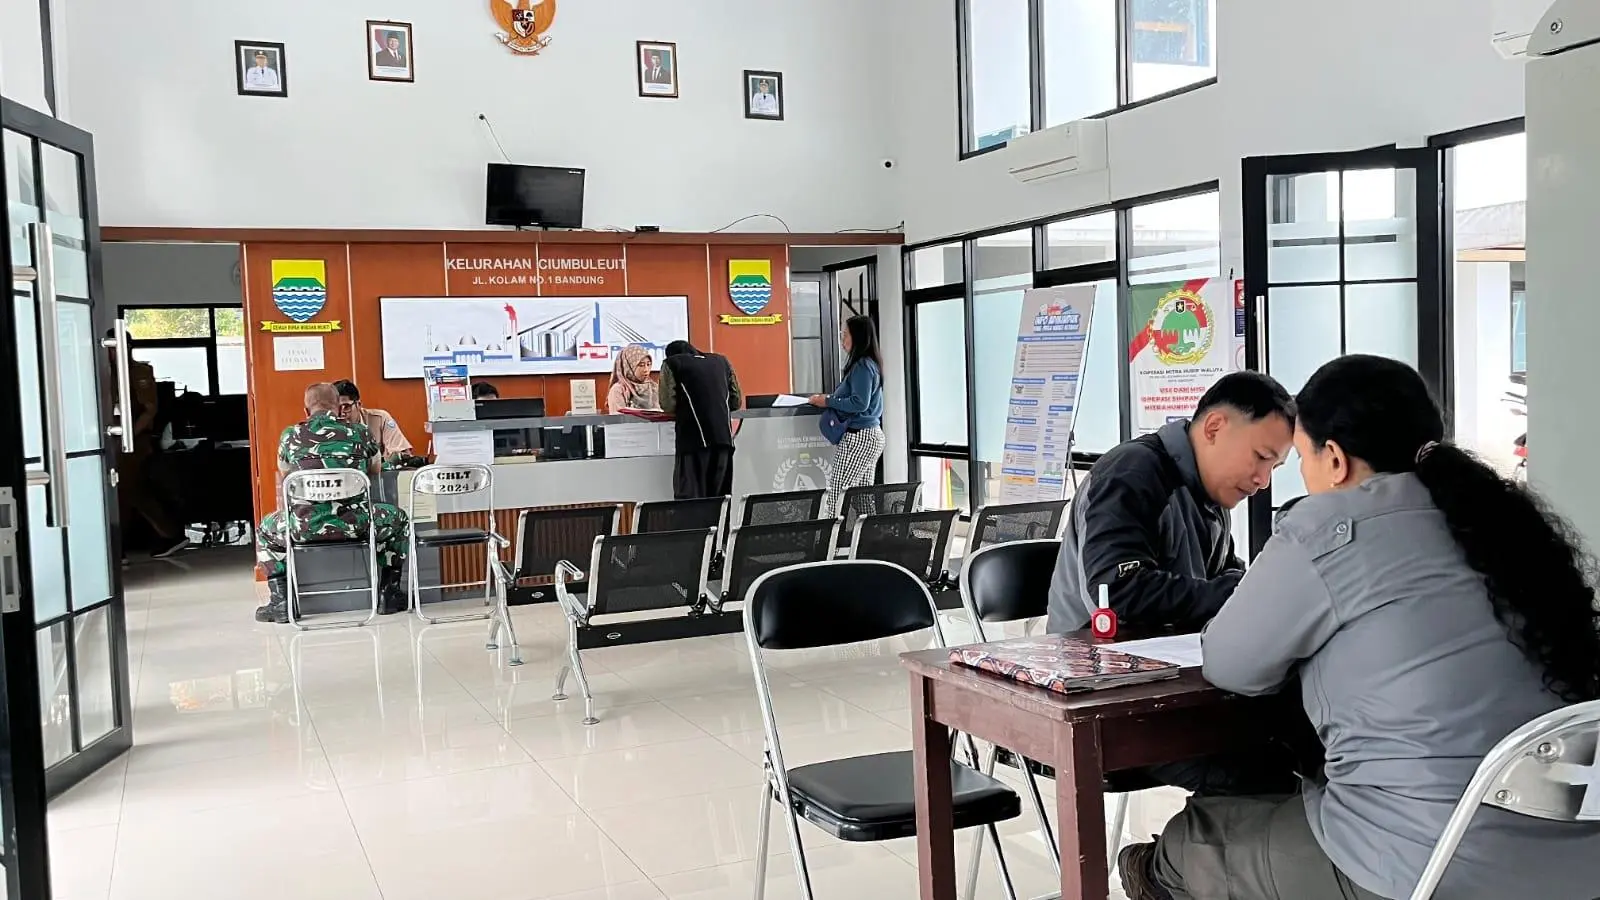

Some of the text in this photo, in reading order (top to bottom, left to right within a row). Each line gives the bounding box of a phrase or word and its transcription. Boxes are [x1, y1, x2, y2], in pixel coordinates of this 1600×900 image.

[446, 258, 626, 270] KELURAHAN CIUMBULEUIT
[472, 276, 488, 285] JL.
[489, 276, 526, 285] KOLAM
[555, 276, 604, 285] BANDUNG
[436, 470, 471, 481] CBLT
[306, 479, 343, 488] CBLT
[439, 483, 470, 492] 2024
